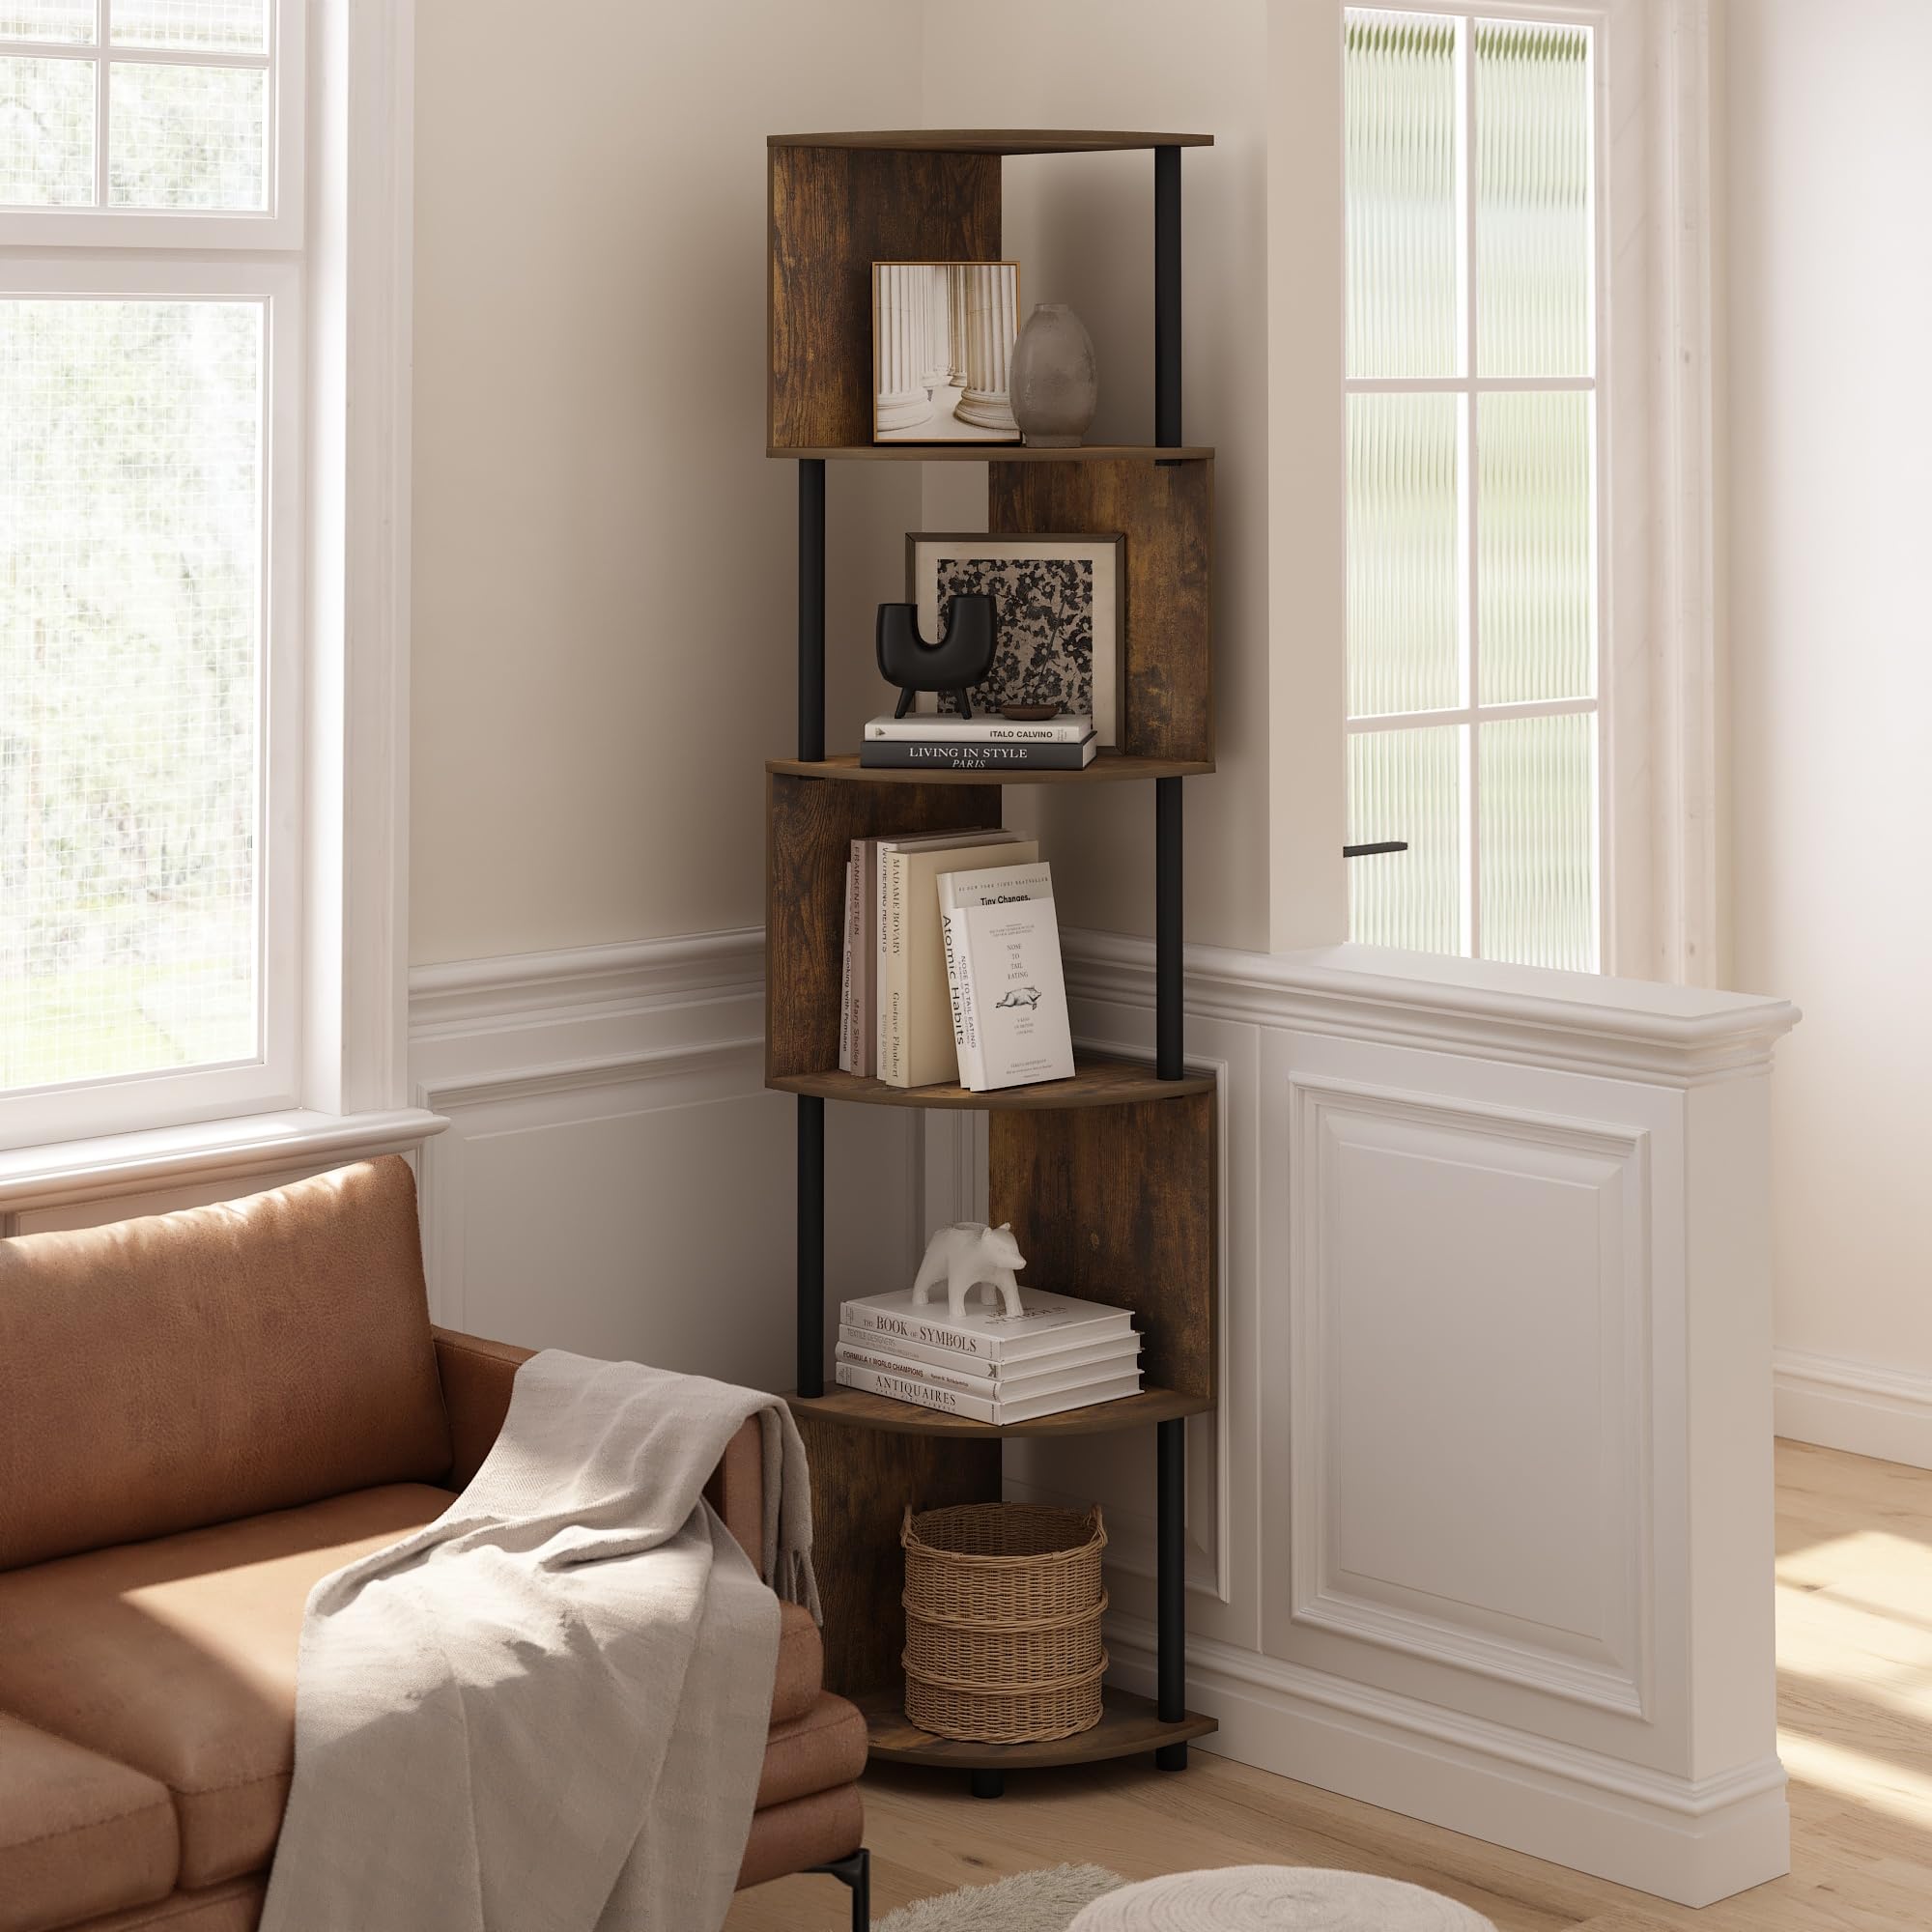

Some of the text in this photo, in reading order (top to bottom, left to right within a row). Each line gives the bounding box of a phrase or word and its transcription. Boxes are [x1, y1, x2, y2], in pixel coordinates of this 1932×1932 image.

[909, 747, 1027, 758] LIVING IN STYLE
[952, 759, 985, 768] PARIS
[943, 915, 956, 980] Atomic
[952, 987, 964, 1045] Habits
[876, 1316, 909, 1336] BOOK
[920, 1326, 977, 1352] SYMBOLS
[842, 1350, 868, 1364] FORMULA
[872, 1358, 892, 1369] WORLD
[892, 1363, 923, 1378] CHAMPIONS
[875, 1376, 956, 1406] ANTIQUAIRES
